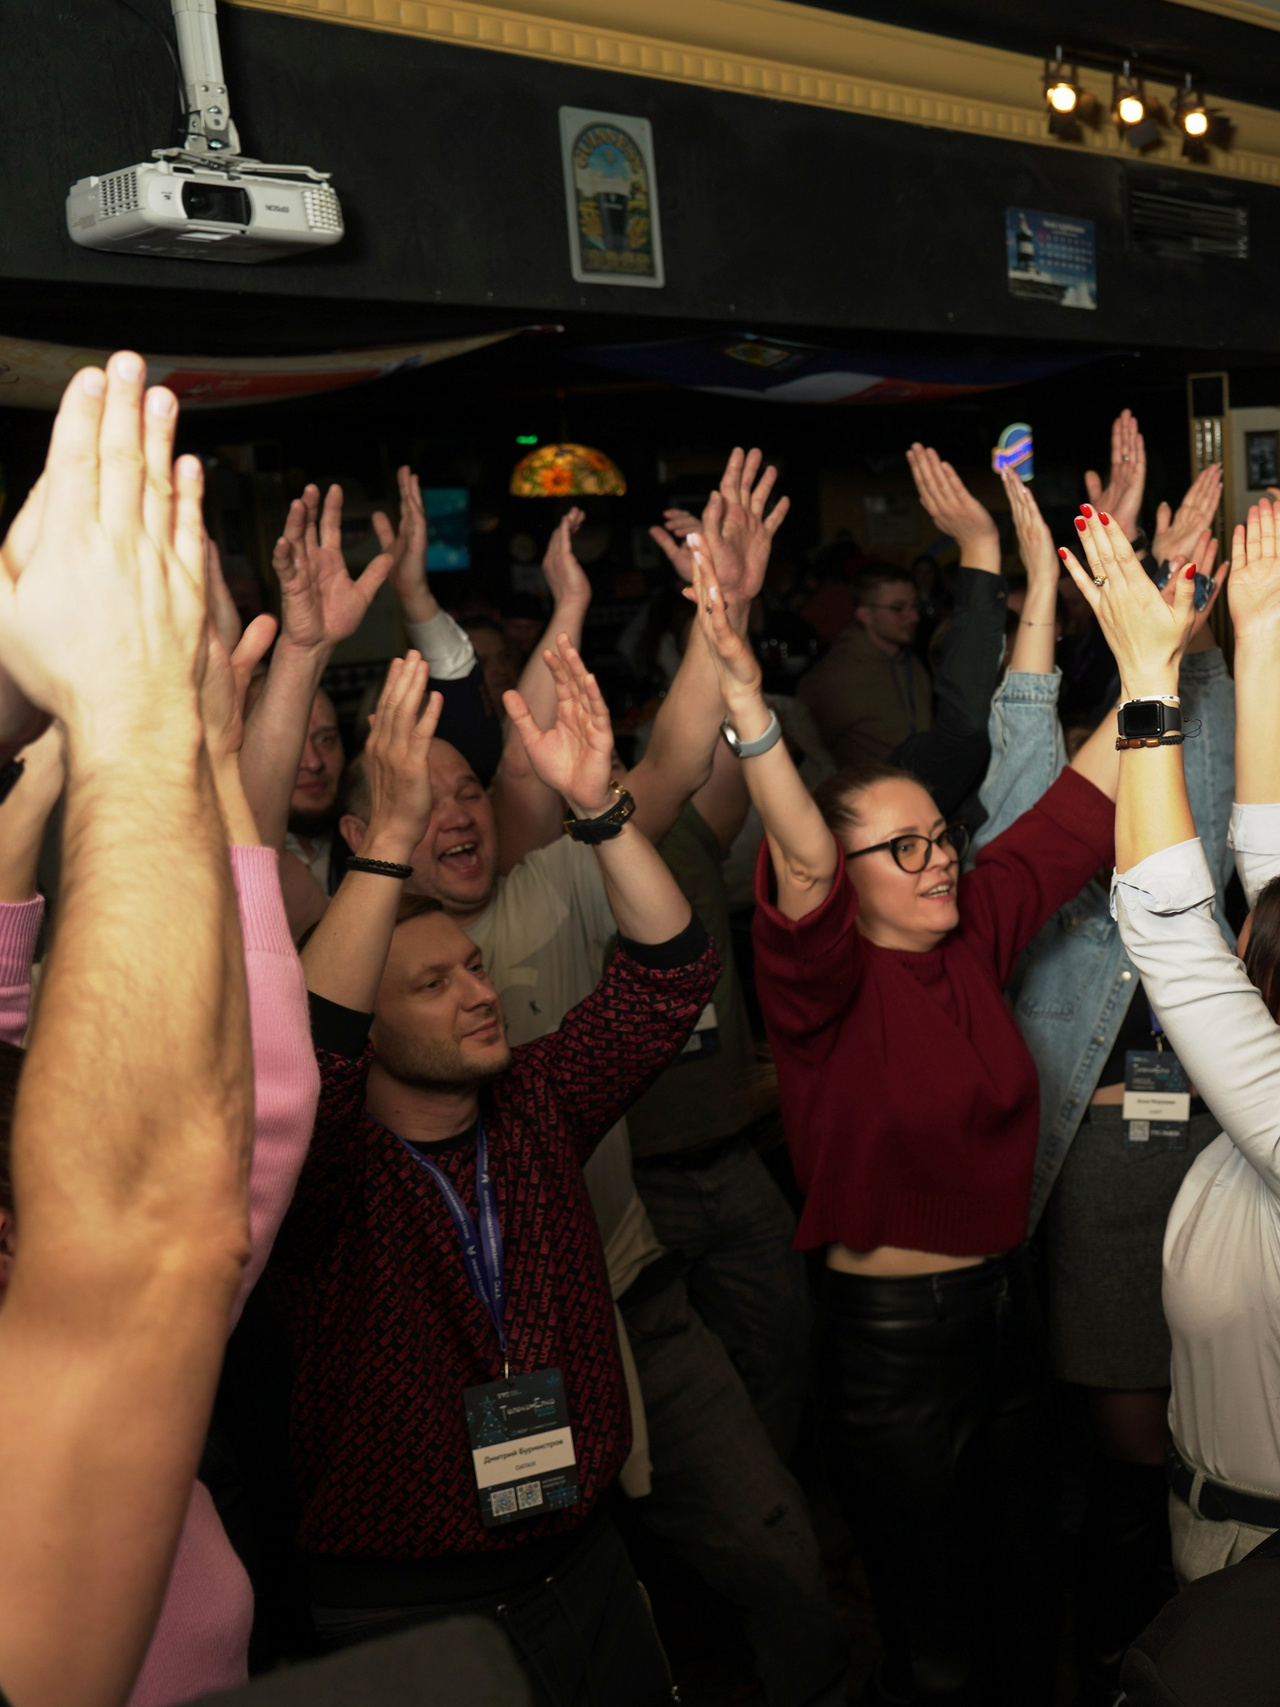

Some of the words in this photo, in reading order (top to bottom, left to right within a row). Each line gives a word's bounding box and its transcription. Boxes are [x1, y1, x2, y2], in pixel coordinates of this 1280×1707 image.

[574, 130, 641, 173] GUINNESS
[265, 204, 290, 213] EPSON
[484, 1449, 517, 1464] Дмитрий
[519, 1439, 563, 1455] Бурмистров
